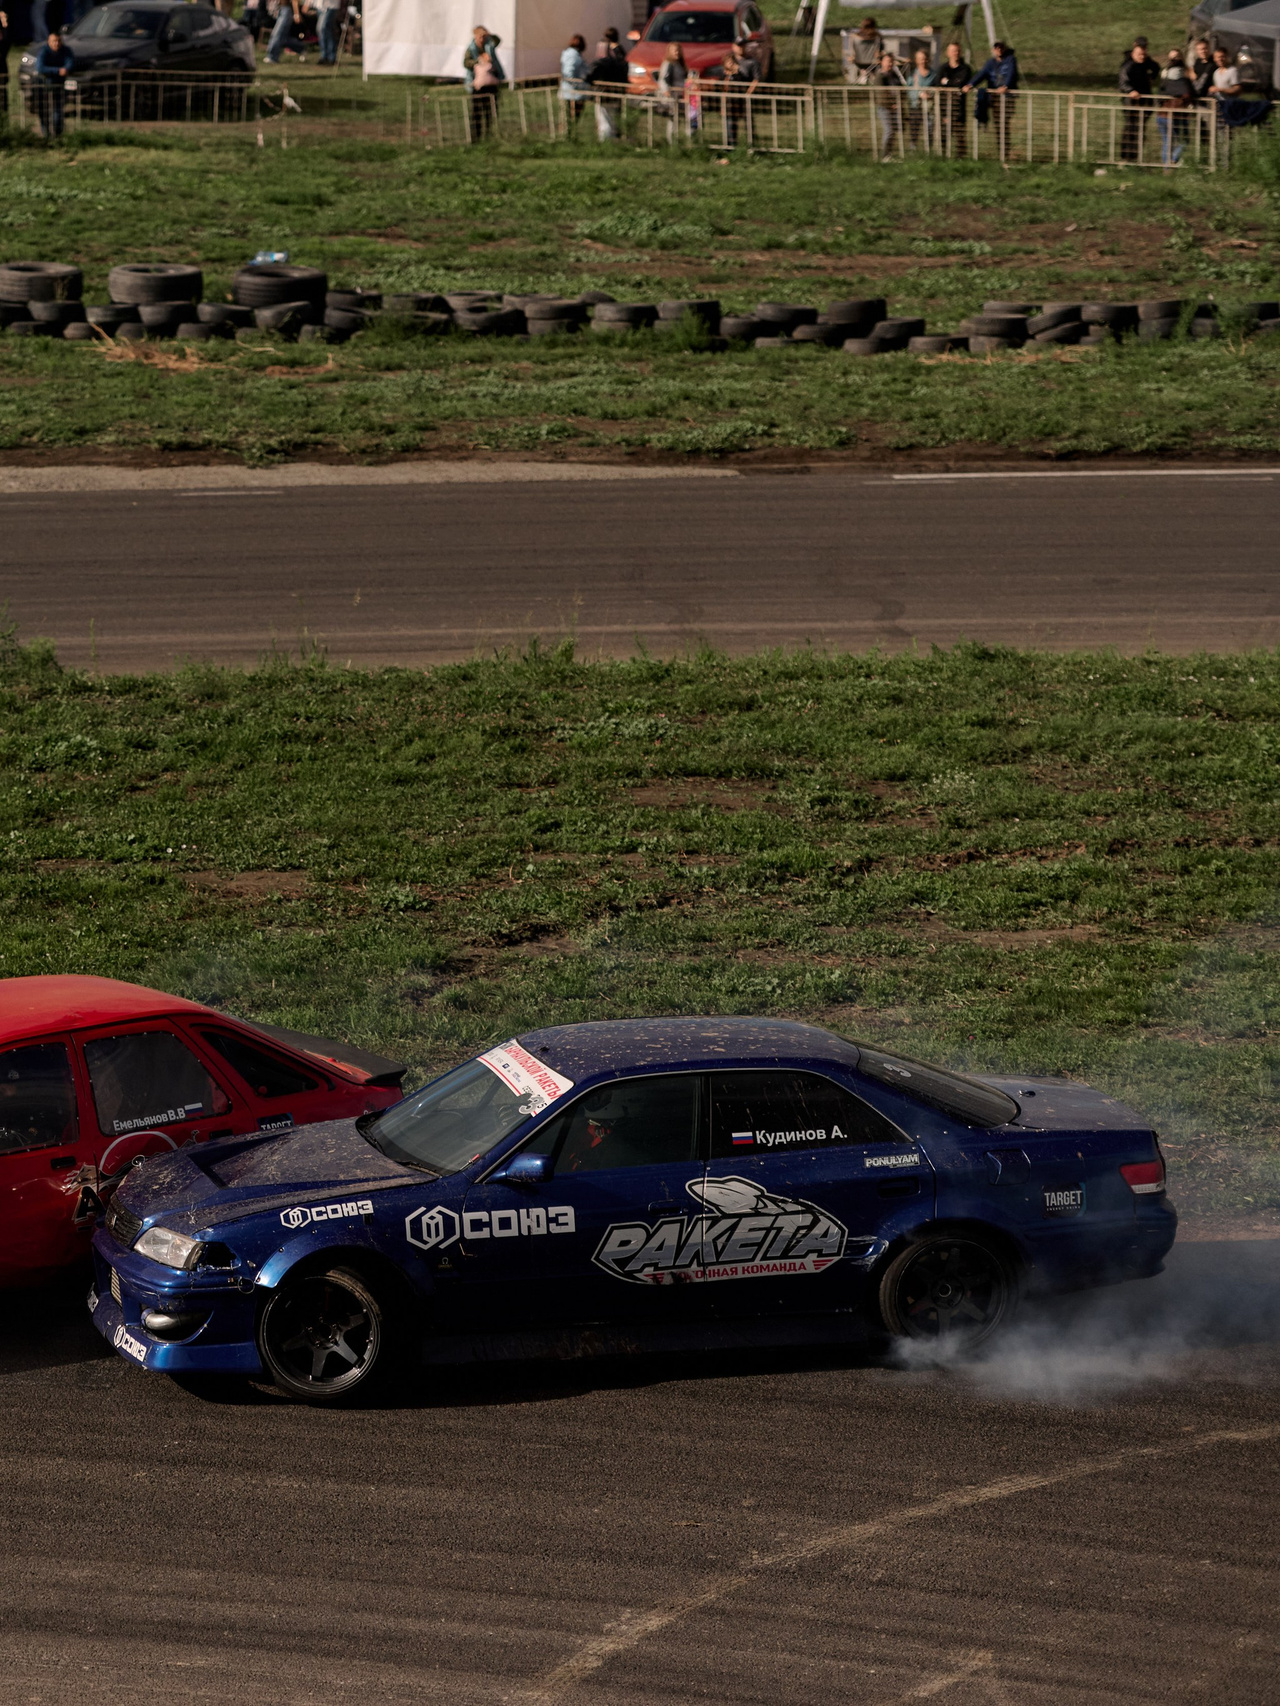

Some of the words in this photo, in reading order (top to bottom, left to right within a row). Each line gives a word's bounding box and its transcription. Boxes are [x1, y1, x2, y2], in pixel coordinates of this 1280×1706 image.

[113, 1113, 169, 1131] Емельянов
[755, 1129, 827, 1146] Кудинов
[831, 1125, 848, 1139] А.
[865, 1153, 919, 1168] PONULYAM
[1044, 1190, 1082, 1206] TARGET
[311, 1200, 374, 1221] СОЮЗ
[462, 1205, 576, 1239] СОЮЗ
[598, 1212, 843, 1272] РАКЕТА
[742, 1262, 808, 1275] КОМАНДА
